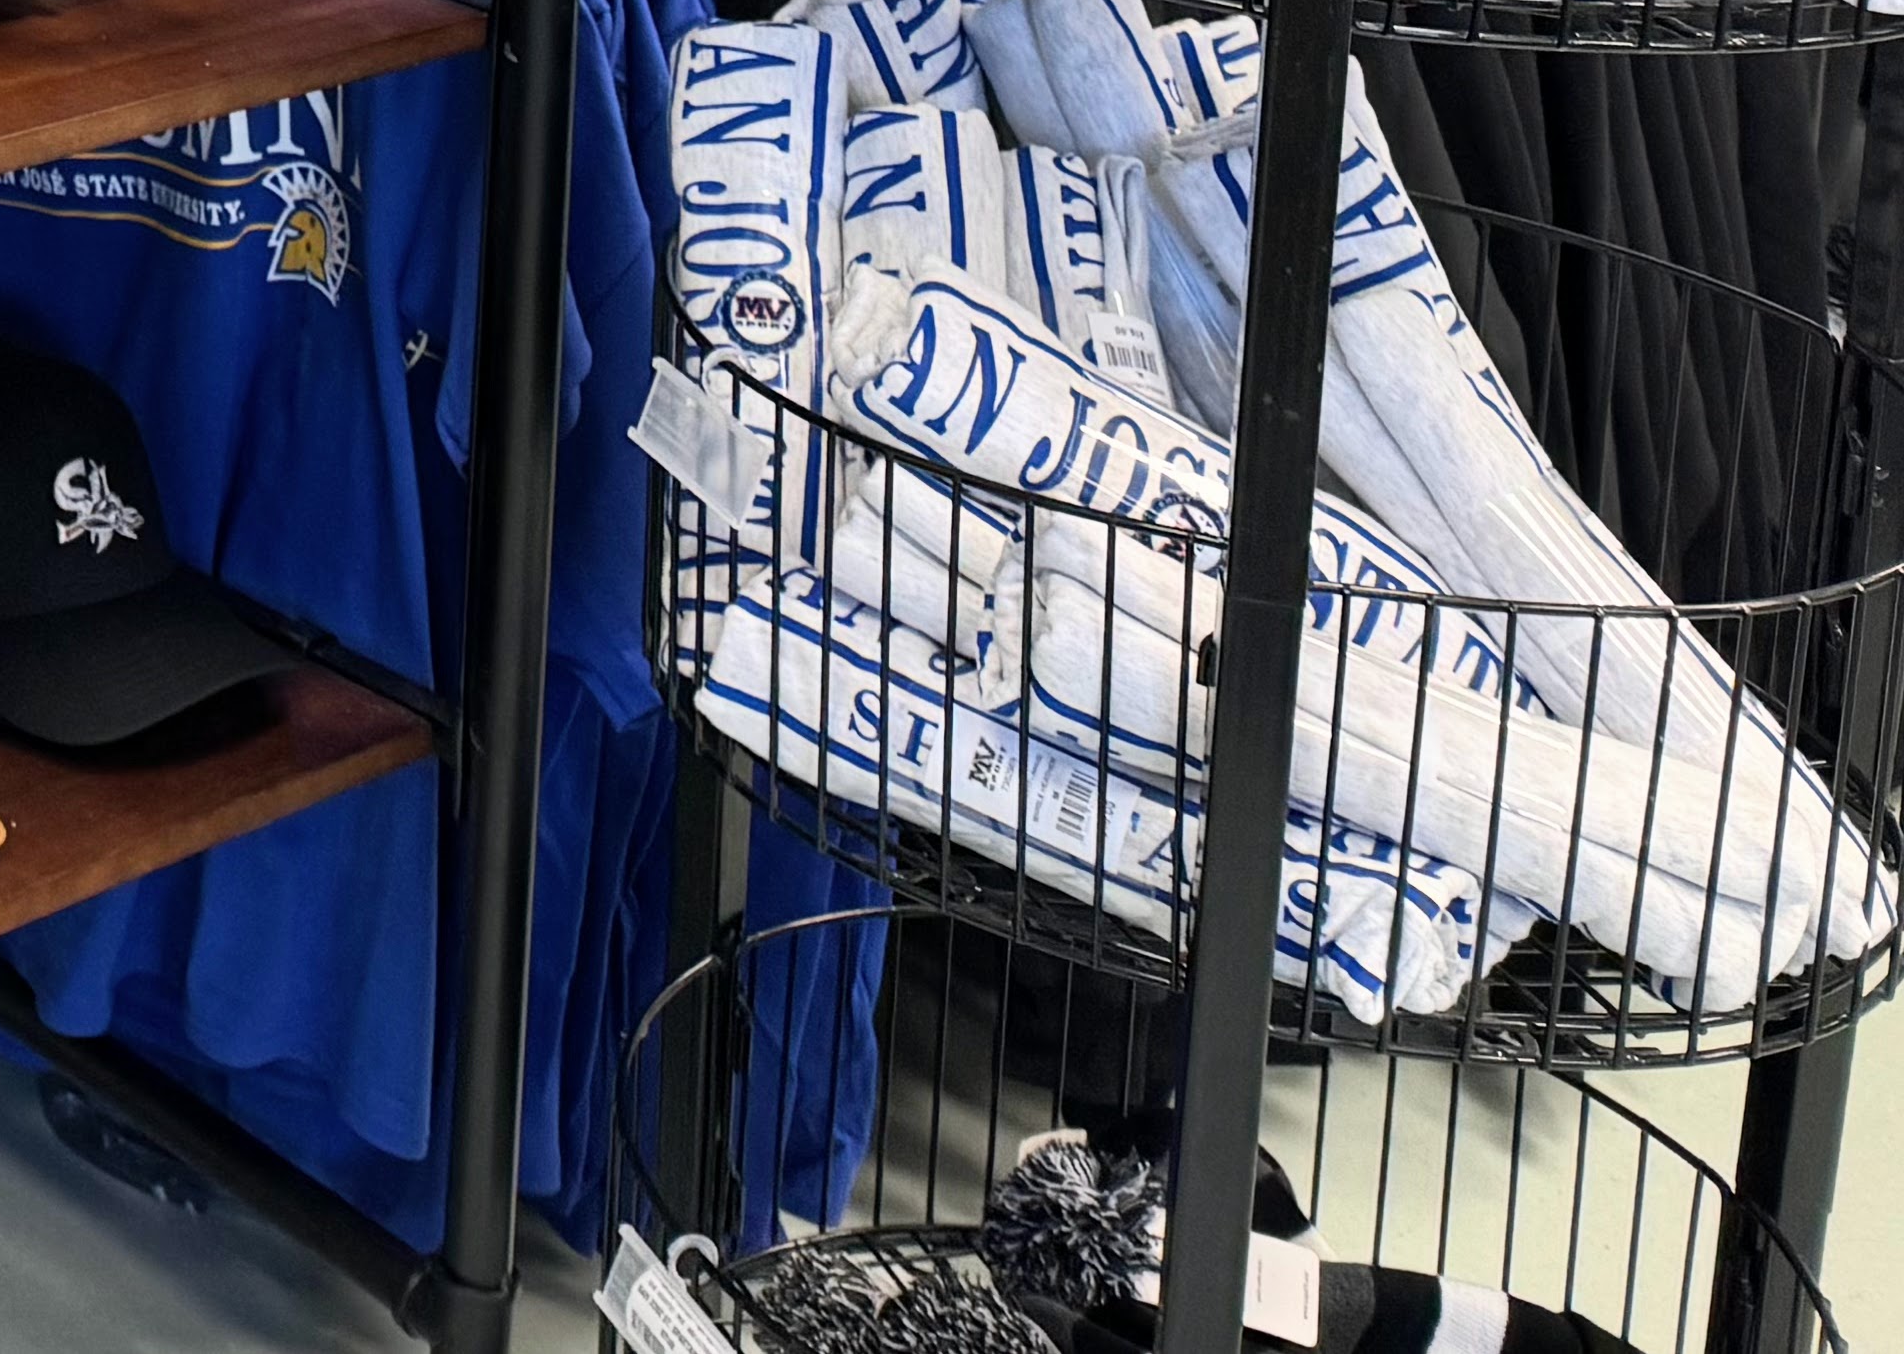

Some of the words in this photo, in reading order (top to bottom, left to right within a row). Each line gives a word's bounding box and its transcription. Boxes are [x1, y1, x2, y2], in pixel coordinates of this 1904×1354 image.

[681, 39, 796, 154] AN
[73, 174, 148, 201] STATE
[735, 296, 792, 320] MV
[875, 303, 1028, 458] AN
[967, 737, 994, 791] MV
